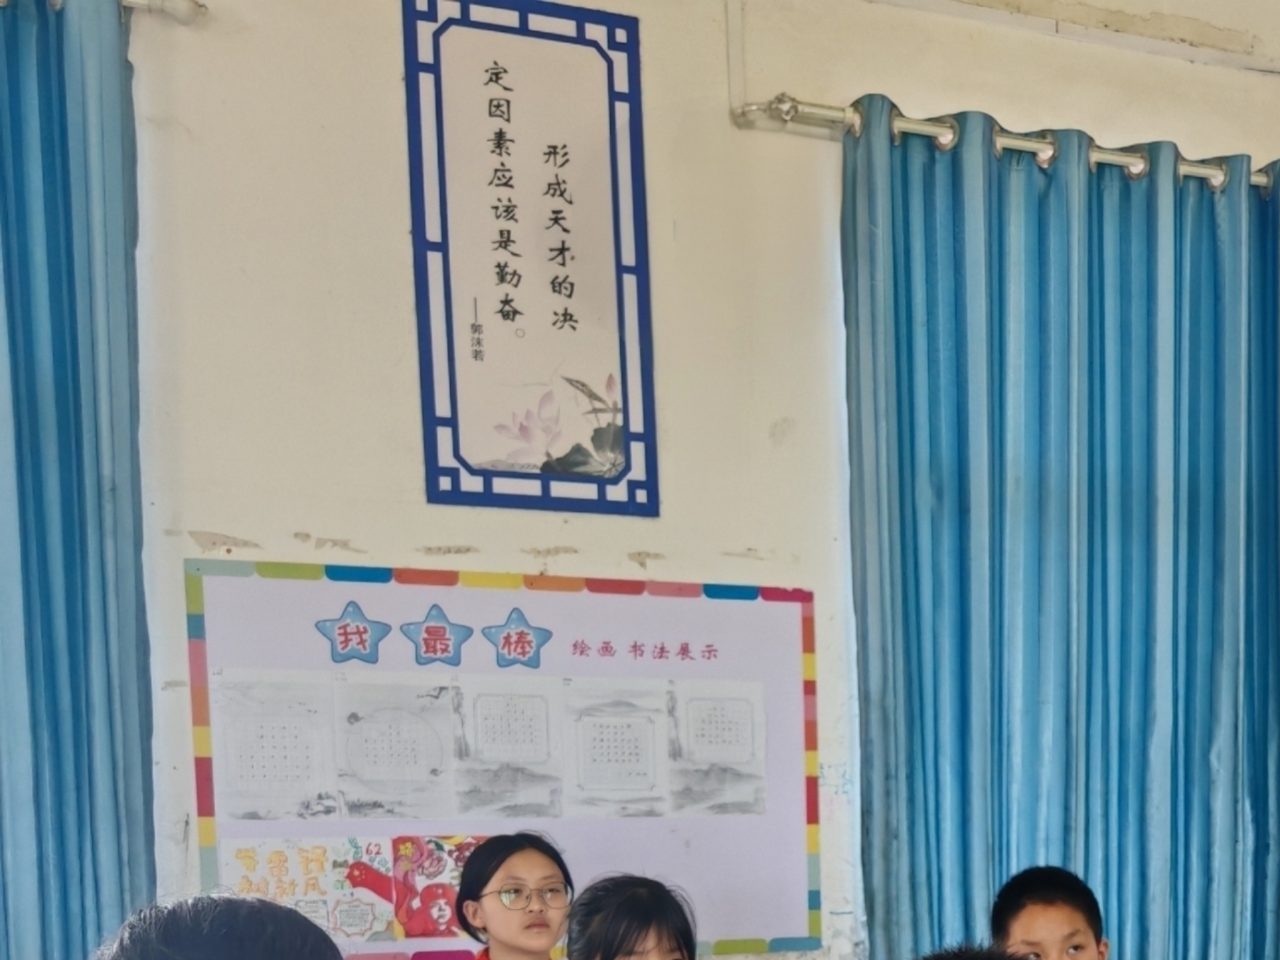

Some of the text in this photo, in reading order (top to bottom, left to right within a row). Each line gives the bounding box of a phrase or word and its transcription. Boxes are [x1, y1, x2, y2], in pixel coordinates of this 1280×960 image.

[542, 143, 579, 332] 形成天才的决
